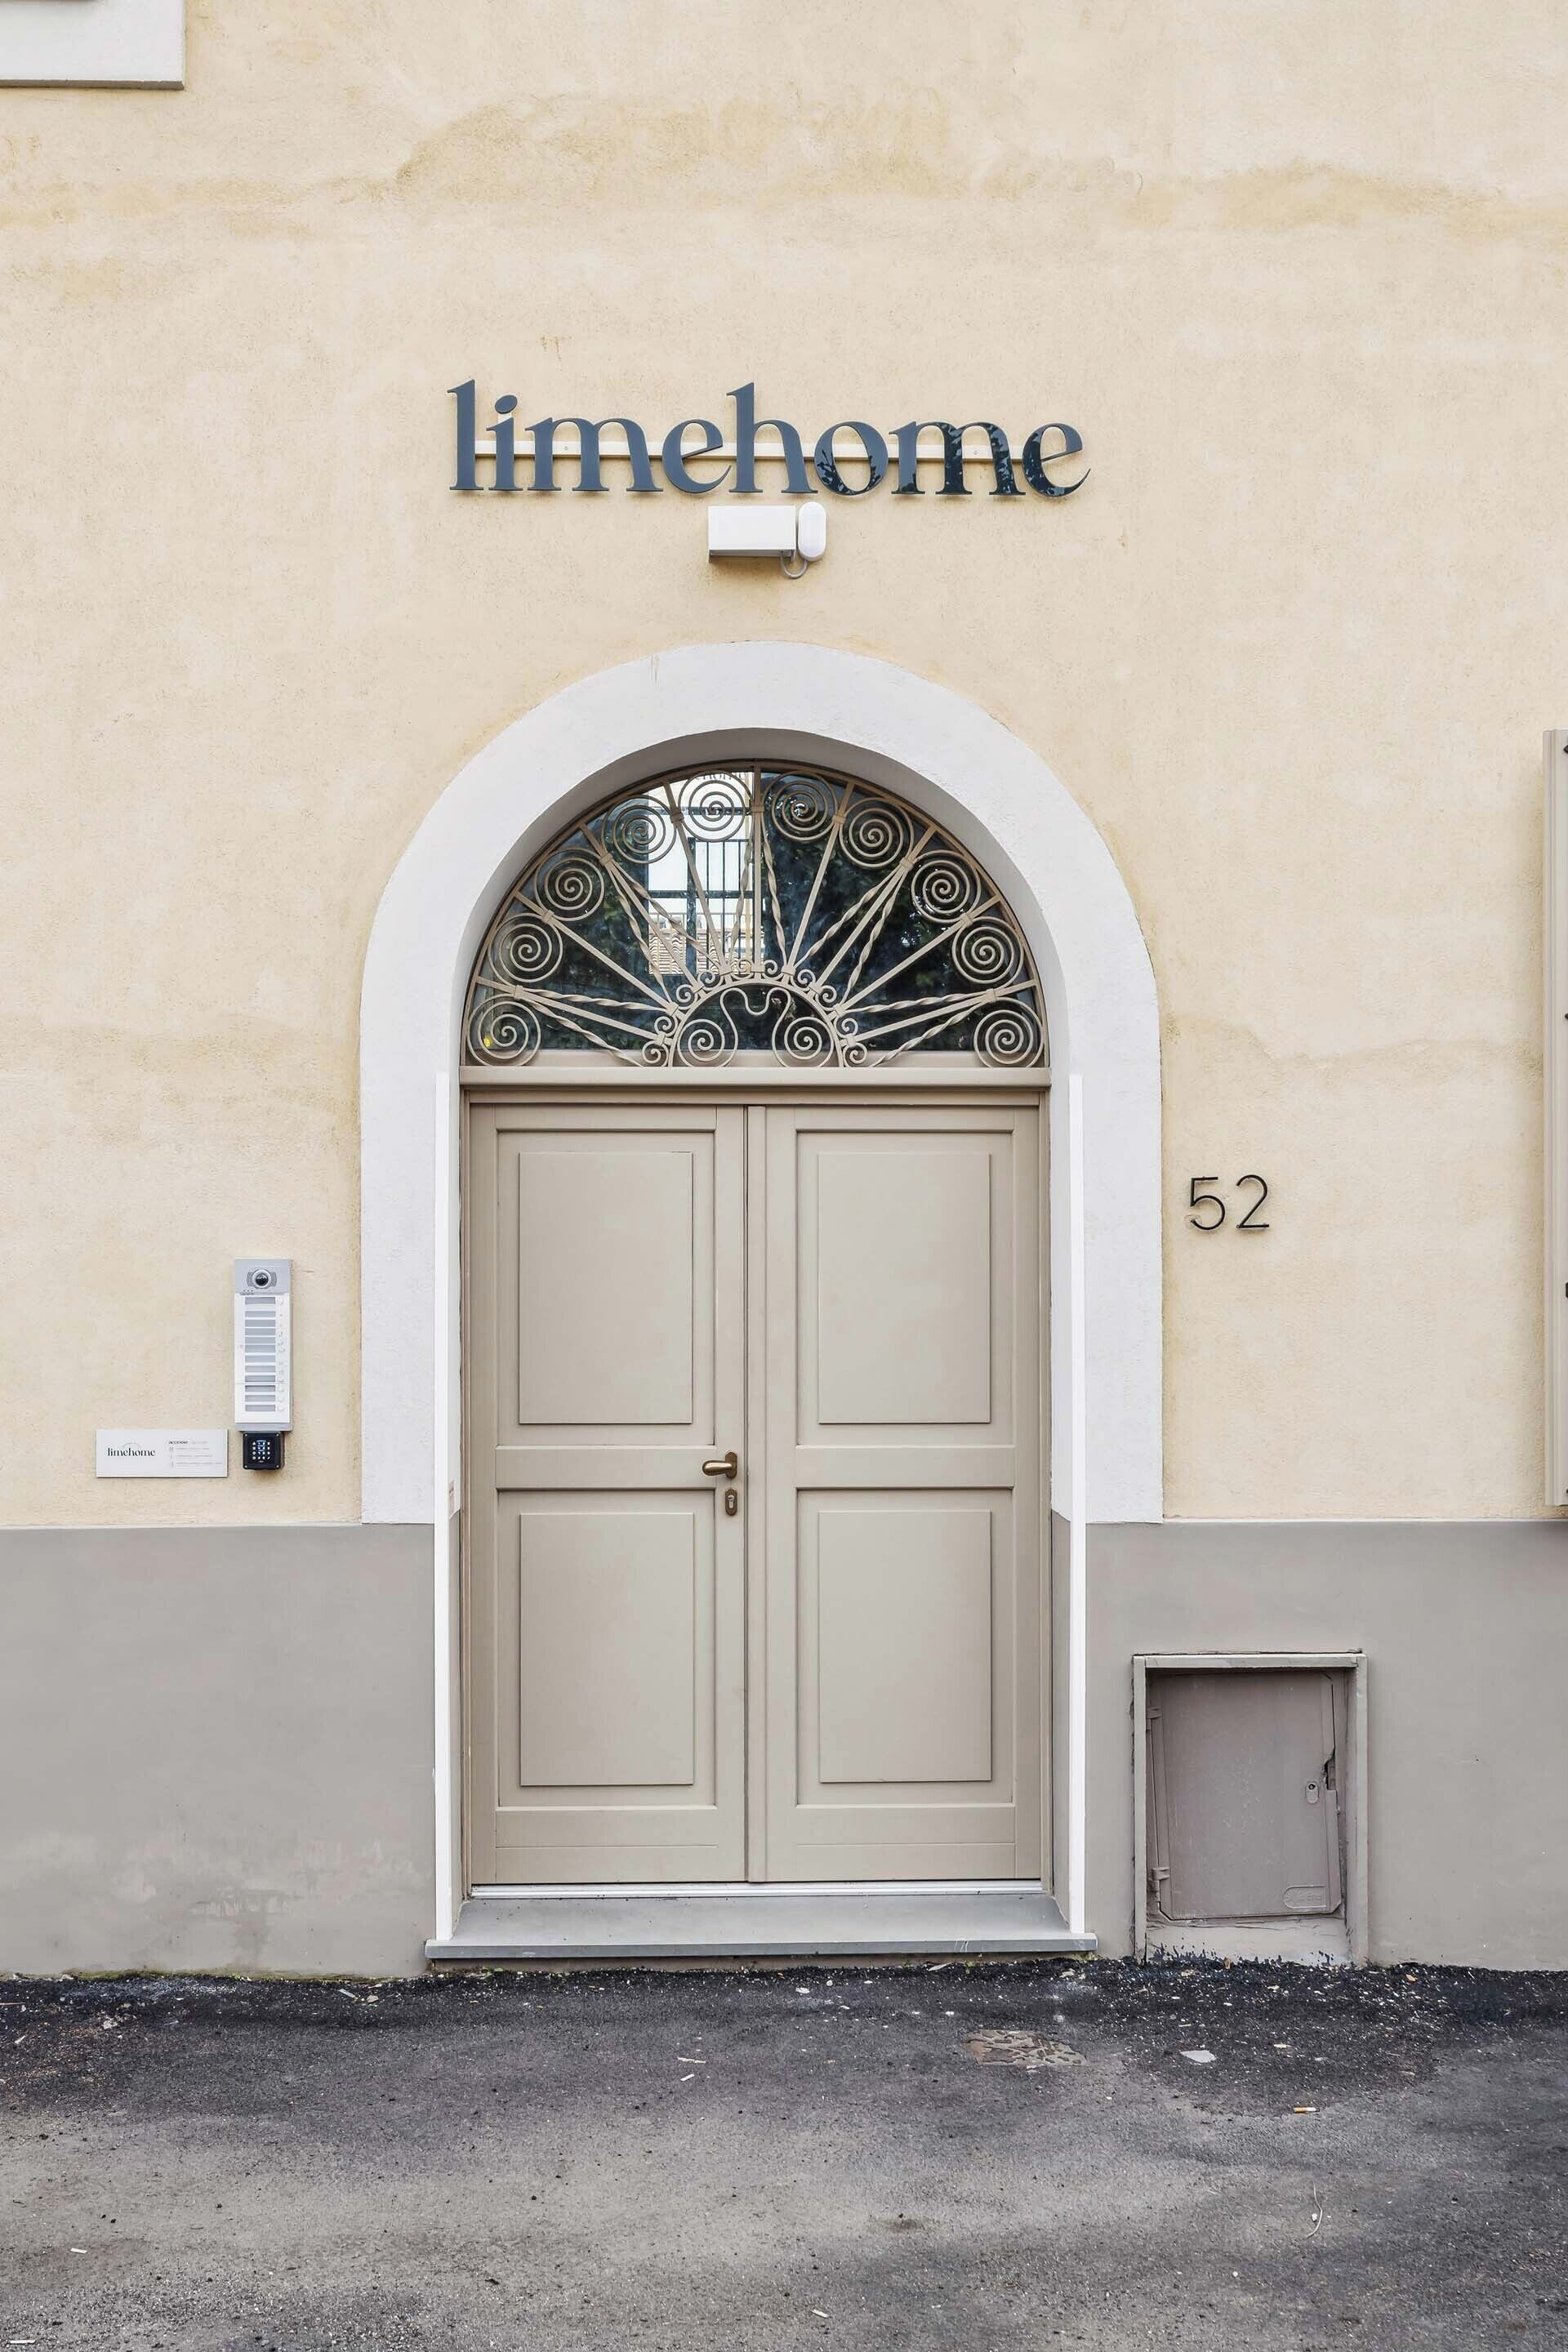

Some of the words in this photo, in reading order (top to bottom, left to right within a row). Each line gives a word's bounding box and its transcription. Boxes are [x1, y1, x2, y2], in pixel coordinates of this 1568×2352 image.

[447, 379, 1091, 498] limehome
[1190, 1174, 1270, 1231] 52
[107, 1447, 156, 1457] limehome
